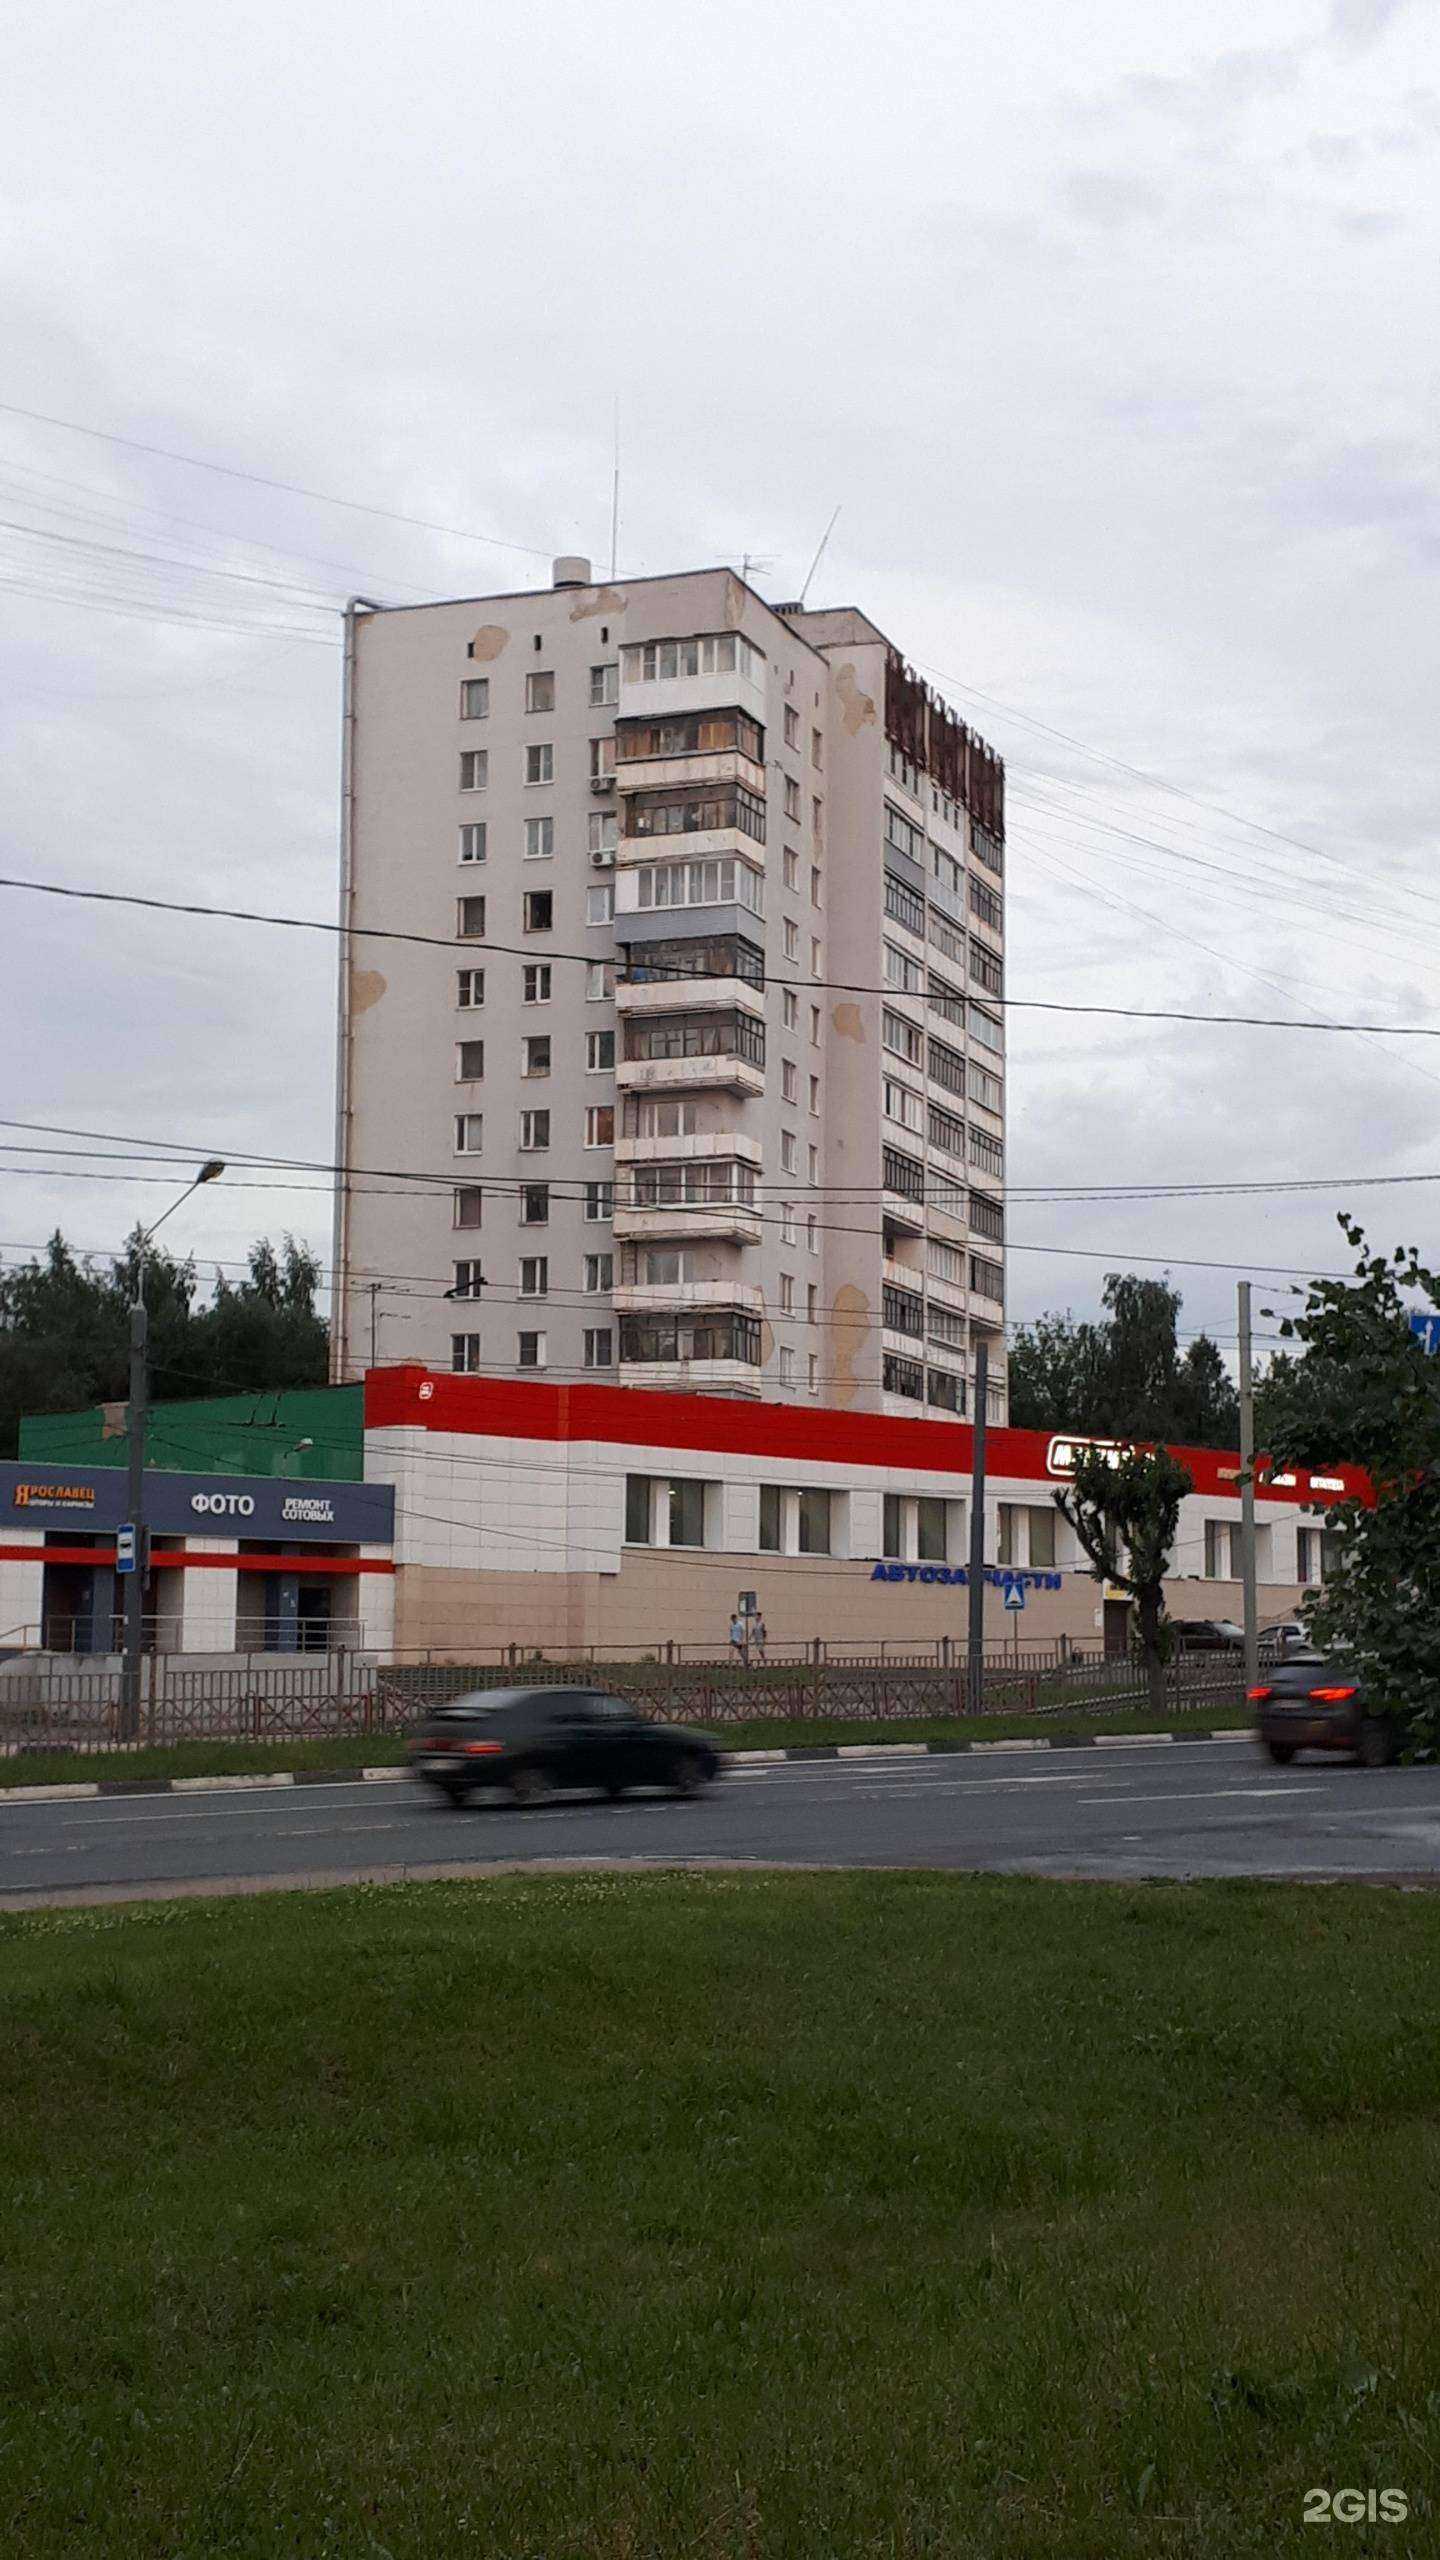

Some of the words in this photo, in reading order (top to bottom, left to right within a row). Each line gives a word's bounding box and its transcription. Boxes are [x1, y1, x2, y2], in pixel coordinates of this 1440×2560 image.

[191, 1493, 255, 1516] ФОТО
[285, 1498, 331, 1510] РЕМОНТ
[282, 1509, 334, 1521] СОТОВЫХ
[870, 1563, 1062, 1590] АВТОЗАЧАСТИ
